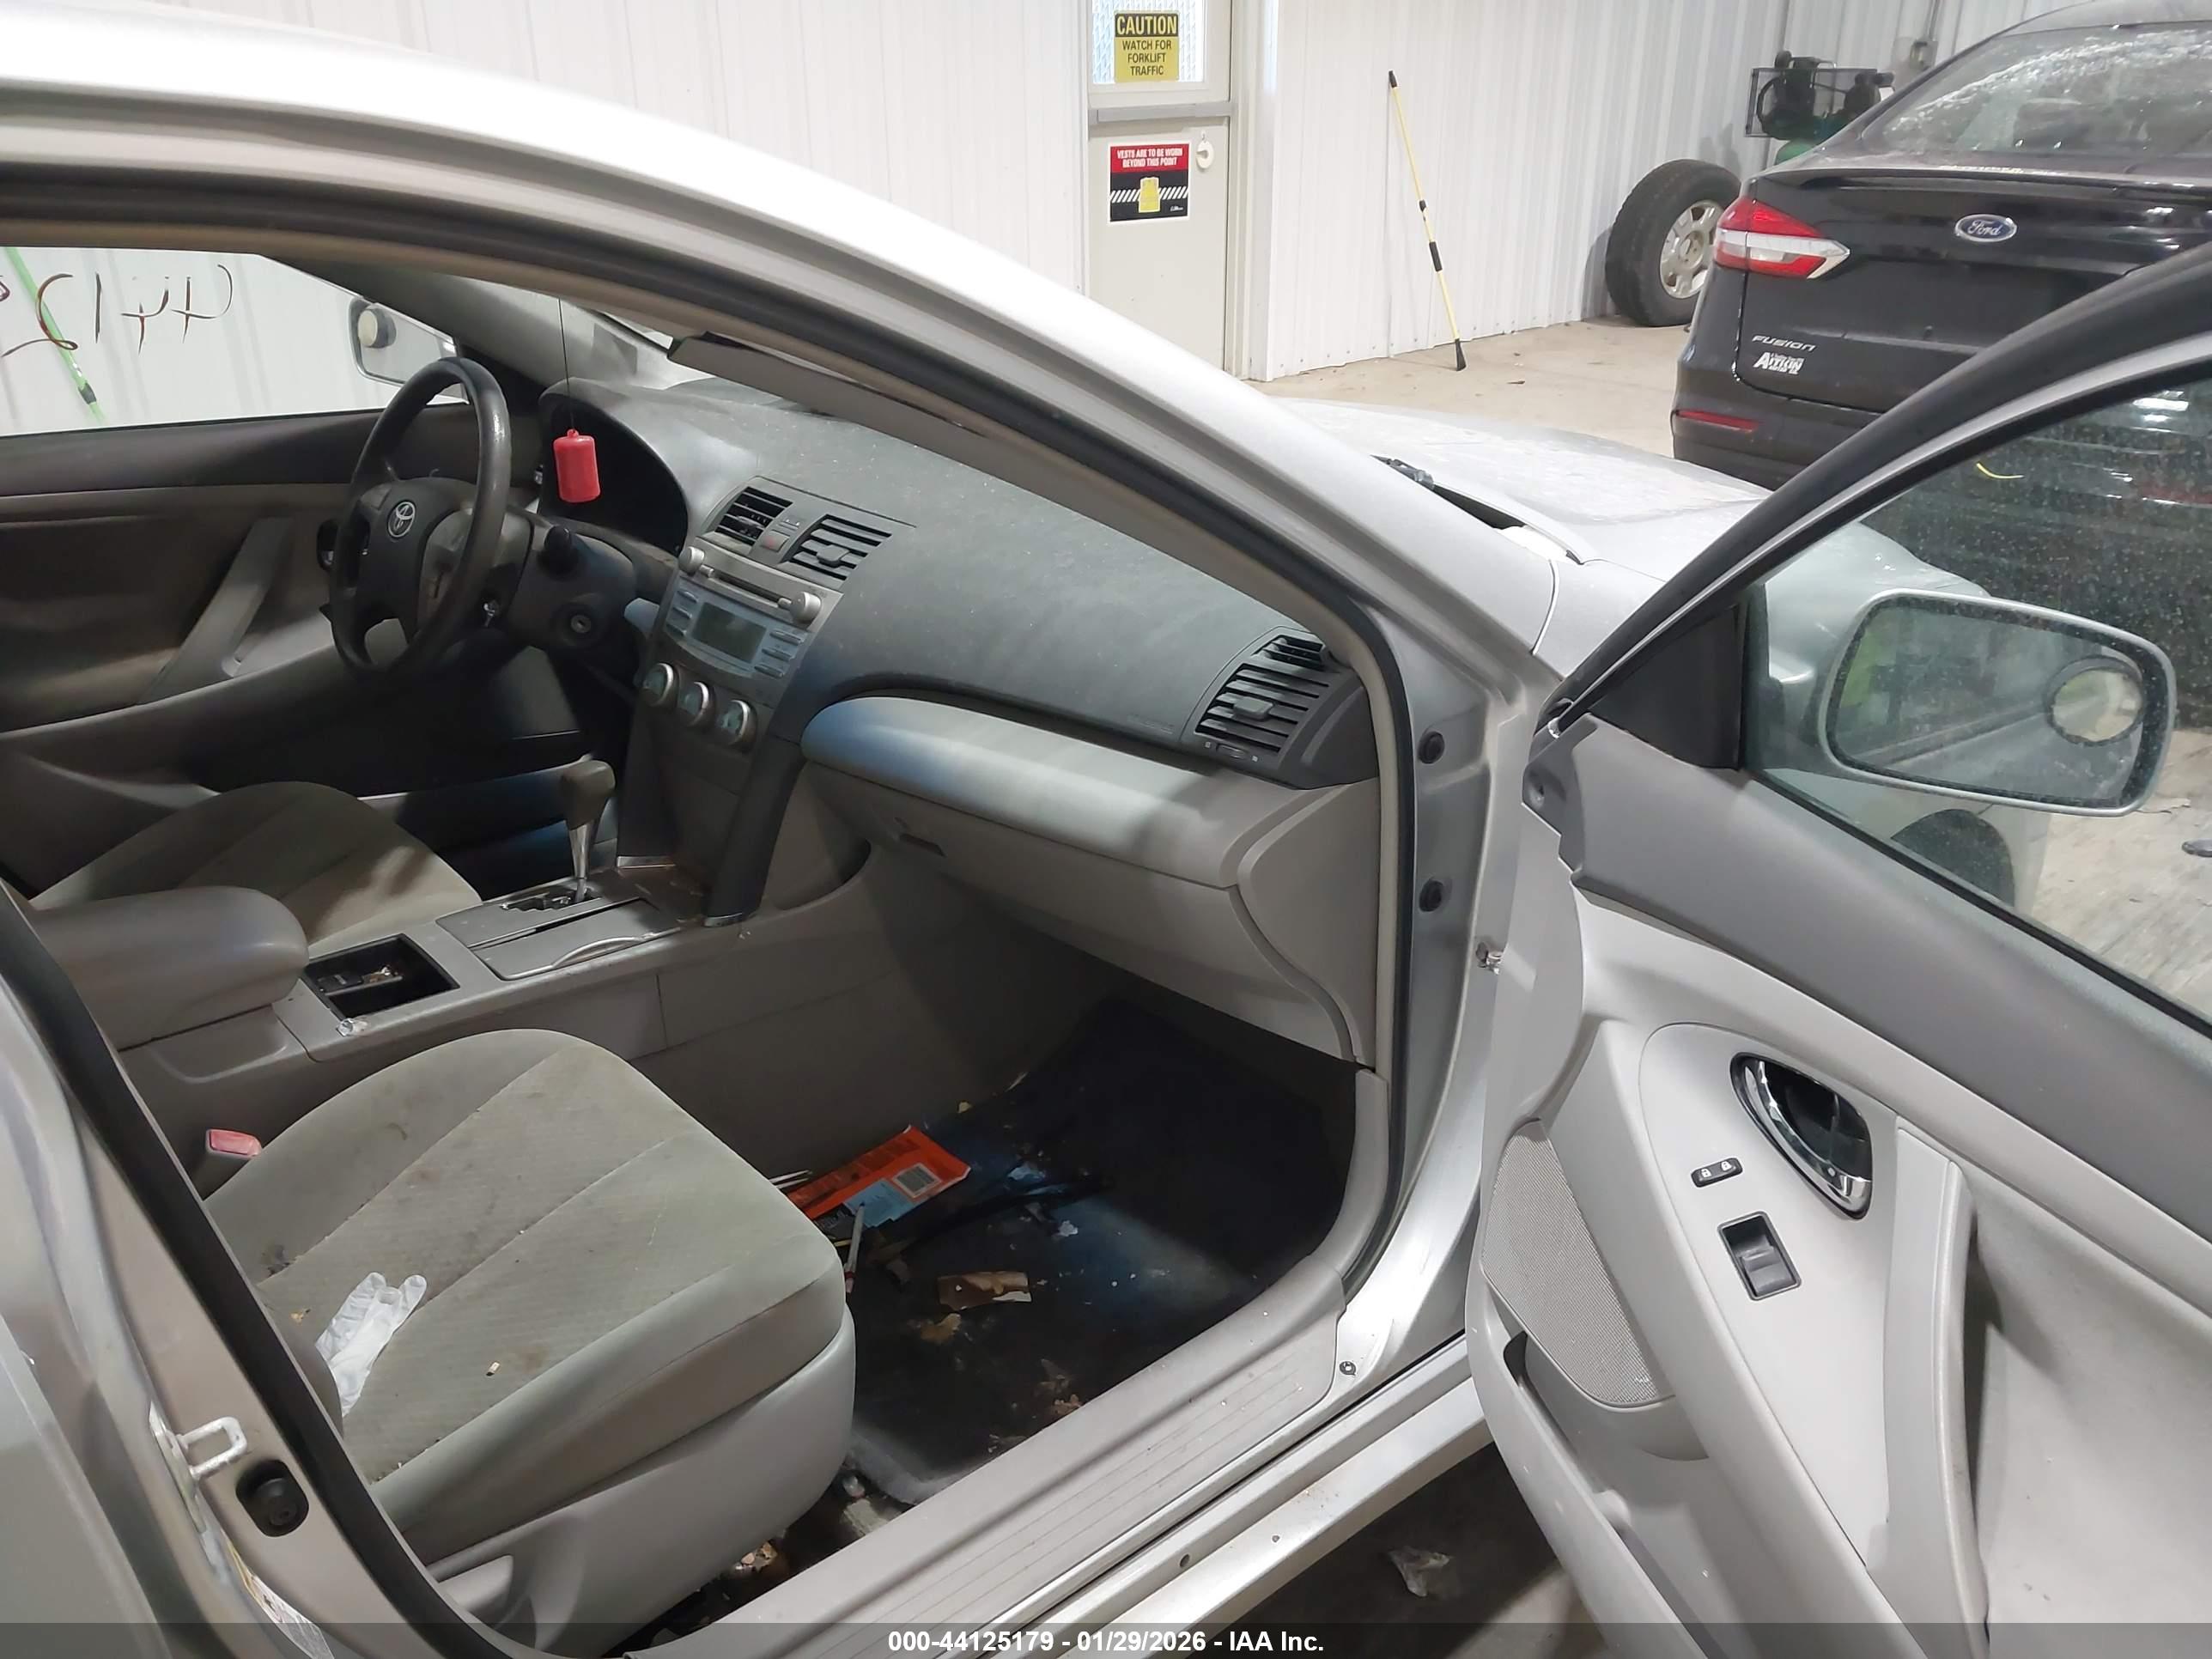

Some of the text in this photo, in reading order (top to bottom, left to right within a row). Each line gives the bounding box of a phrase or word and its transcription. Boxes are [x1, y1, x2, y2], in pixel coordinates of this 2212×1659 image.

[1116, 15, 1177, 35] CAUTION
[1122, 40, 1172, 51] WATCH FOR
[1127, 52, 1166, 64] FORKLIFT
[1130, 65, 1164, 76] TRAFFIC
[1117, 147, 1183, 159] VESTS ARE TO BE WORN
[1122, 157, 1177, 168] BEYOND THIS POINT
[1967, 219, 2004, 236] Ford
